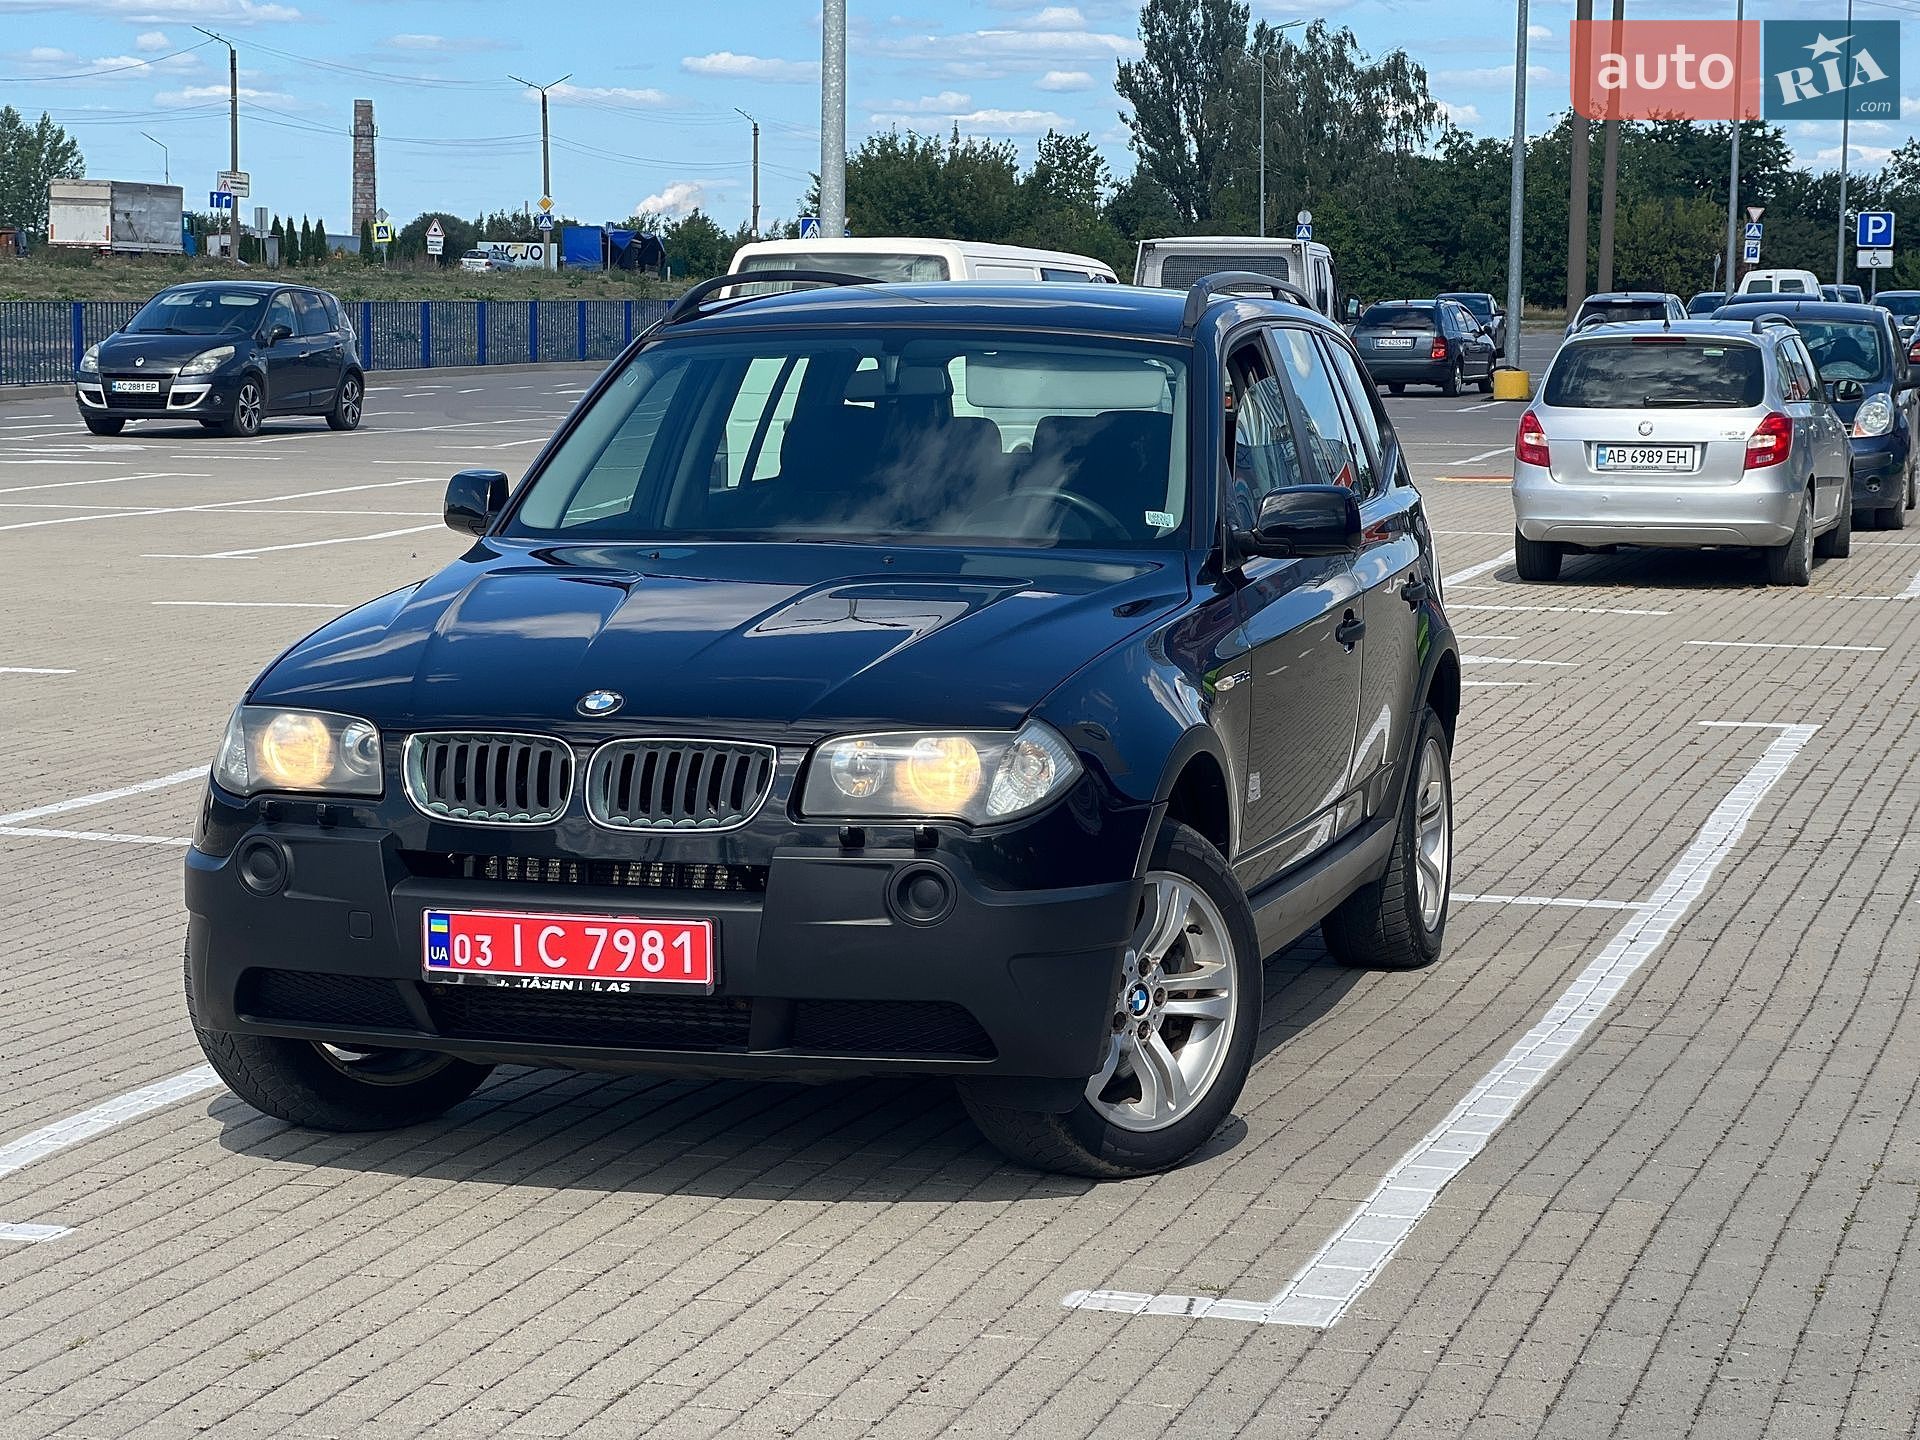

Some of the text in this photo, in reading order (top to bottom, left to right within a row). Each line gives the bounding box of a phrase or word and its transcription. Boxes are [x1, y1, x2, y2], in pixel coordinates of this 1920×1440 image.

[1868, 216, 1887, 243] P
[117, 383, 157, 391] AC 2881 EP
[1607, 450, 1687, 464] AB 6989 EH
[431, 947, 448, 961] UA
[454, 933, 493, 967] 03
[584, 927, 692, 974] 7981
[515, 977, 573, 990] TÅSEN
[606, 982, 631, 993] AS
